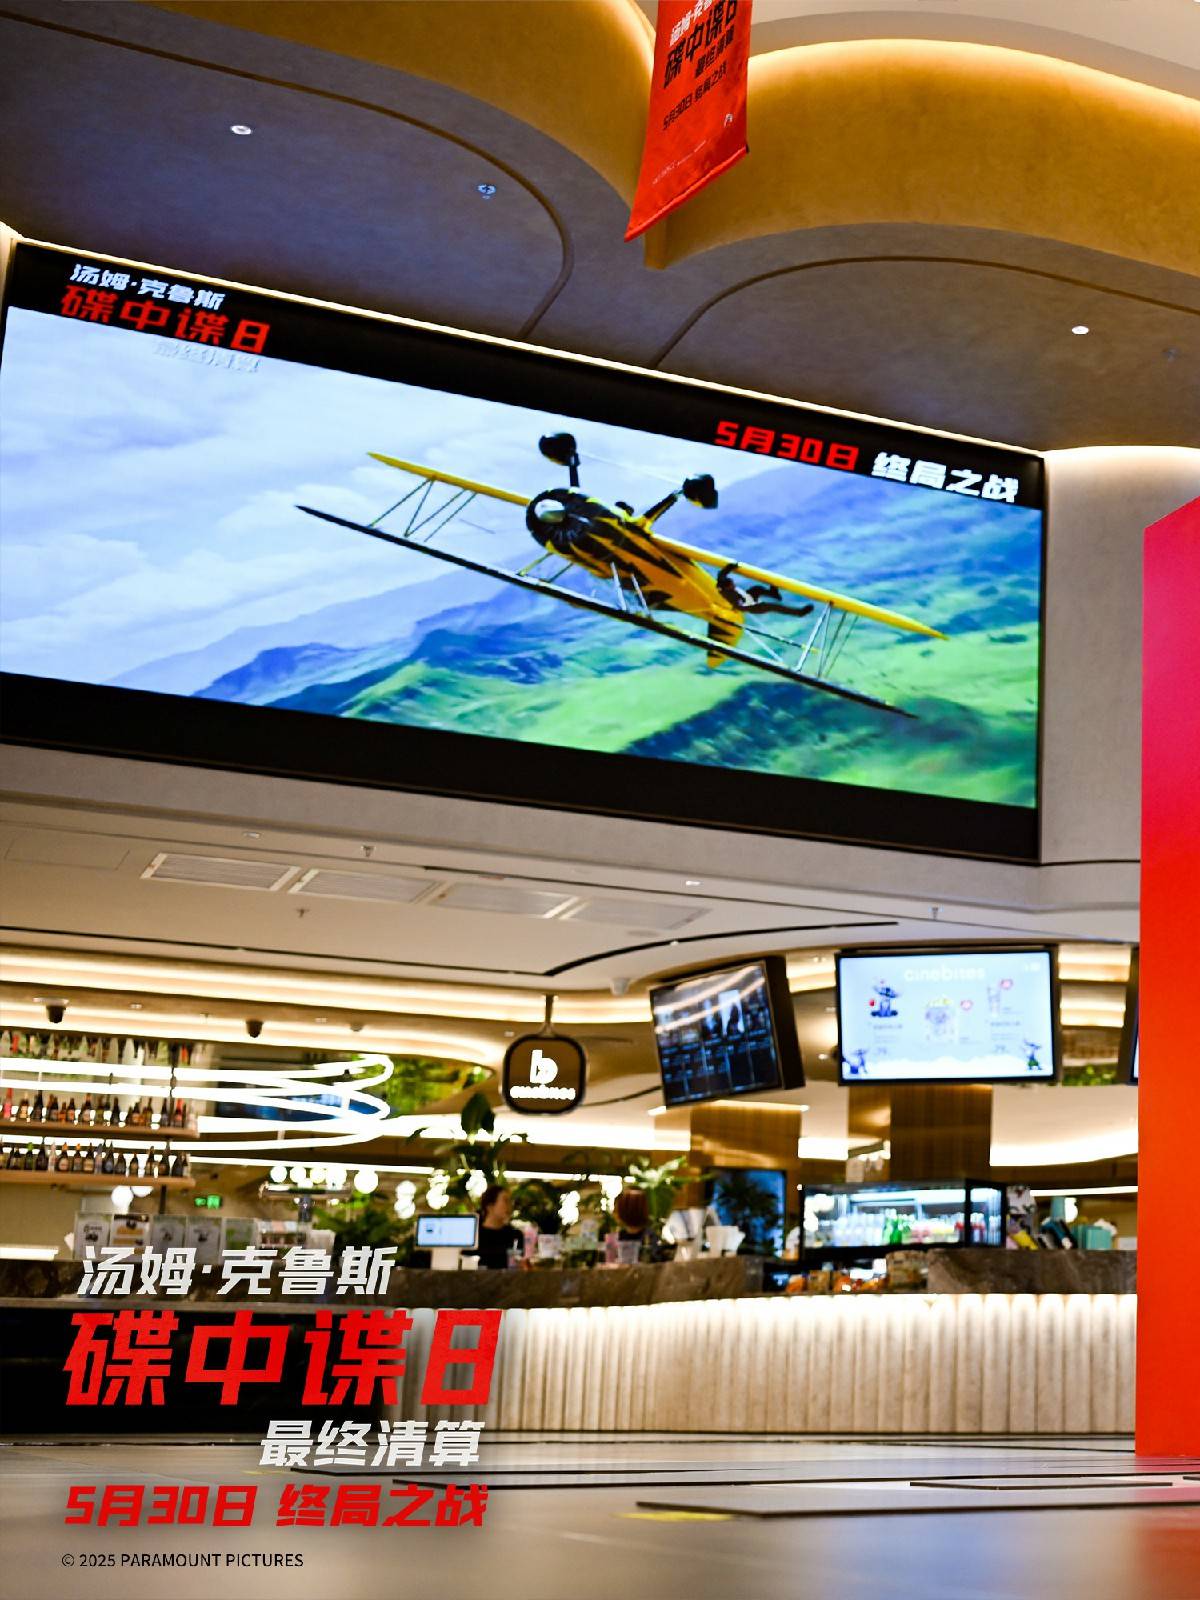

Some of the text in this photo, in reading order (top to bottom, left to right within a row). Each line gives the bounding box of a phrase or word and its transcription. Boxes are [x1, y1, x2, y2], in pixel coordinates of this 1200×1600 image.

[69, 263, 226, 311] 汤姆·克鲁斯
[716, 420, 1019, 503] 5月30日 终局之战
